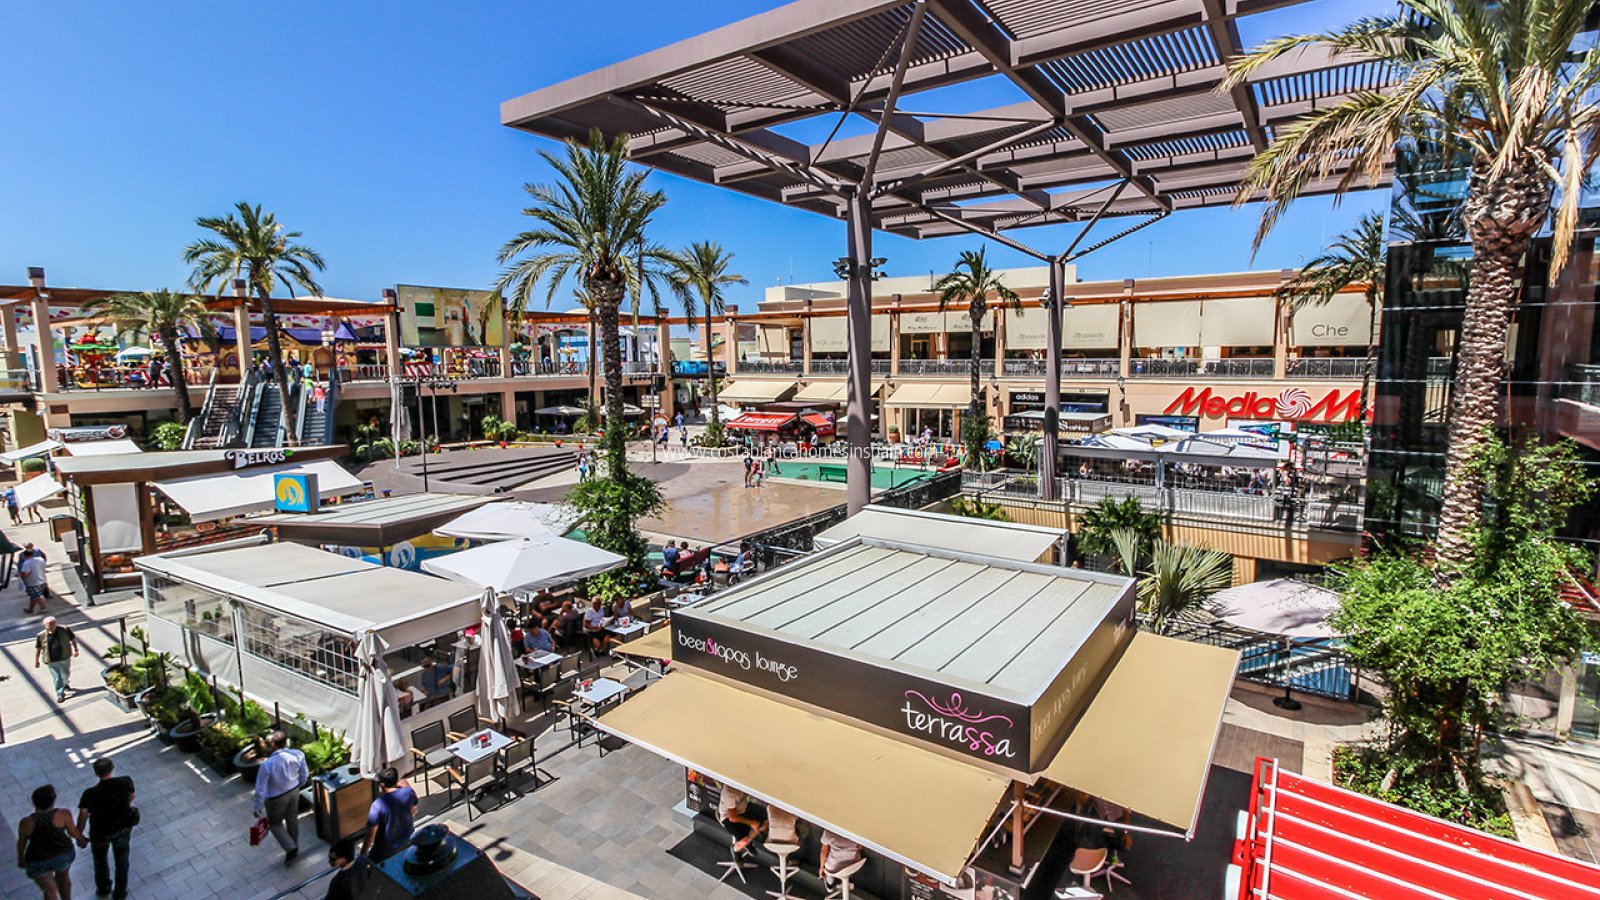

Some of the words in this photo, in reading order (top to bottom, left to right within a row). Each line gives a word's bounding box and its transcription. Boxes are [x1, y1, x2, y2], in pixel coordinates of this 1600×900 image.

[1311, 324, 1349, 337] Che
[1163, 386, 1278, 418] Media
[755, 651, 799, 682] lounge
[900, 701, 1016, 758] terrassa
